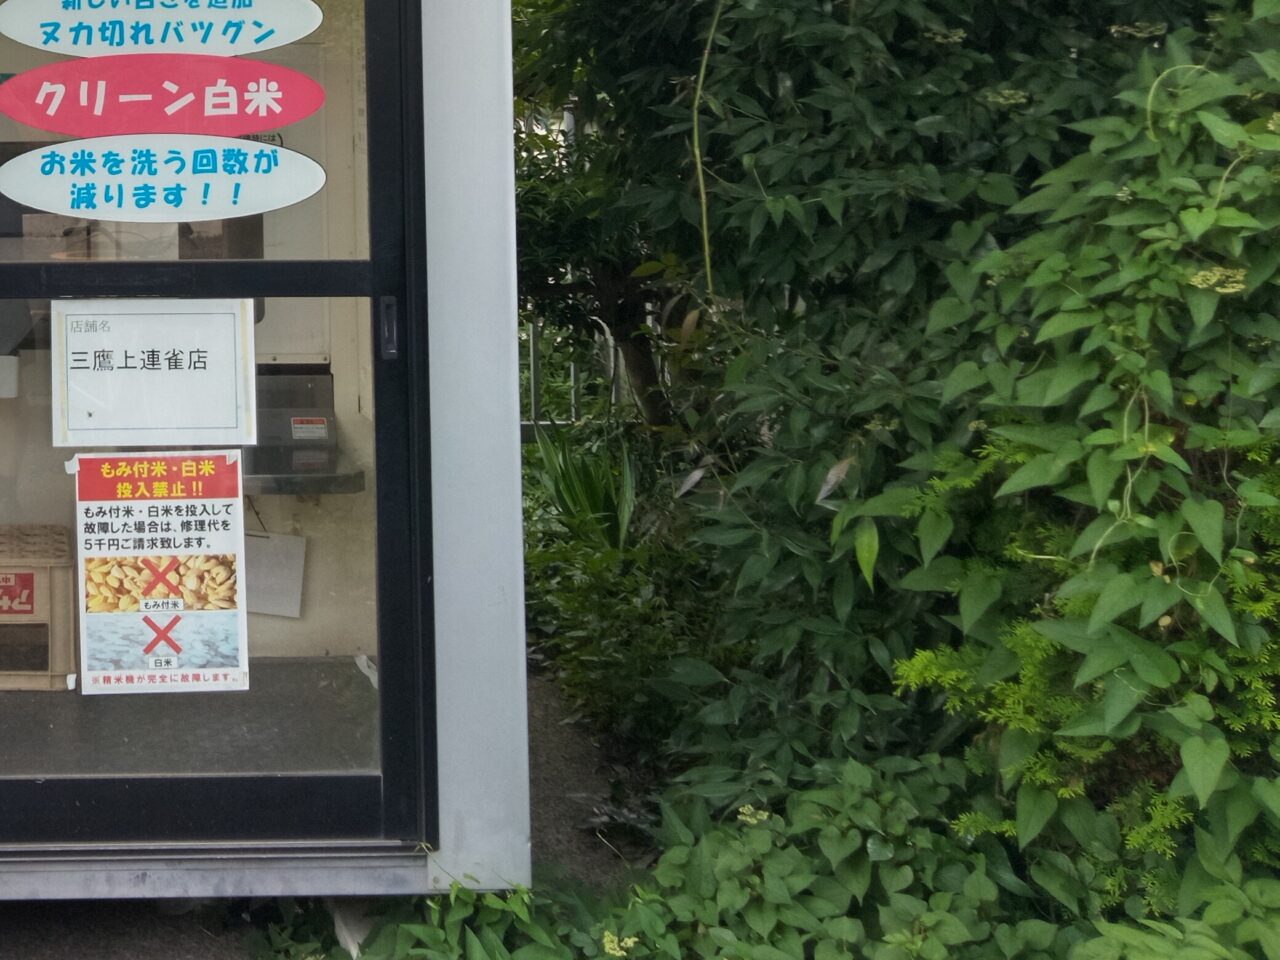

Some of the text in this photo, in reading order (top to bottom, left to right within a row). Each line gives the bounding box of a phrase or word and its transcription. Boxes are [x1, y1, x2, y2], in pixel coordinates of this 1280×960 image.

[39, 20, 276, 48] ヌカ切れバツグン
[35, 78, 283, 117] クリーン白米
[39, 148, 280, 177] お米を洗う回数が
[70, 320, 111, 333] 店舗名
[70, 348, 208, 372] 三鷹上連雀店
[101, 460, 216, 478] もみ付米・白米
[84, 503, 234, 518] もみ付米・白米を投入して
[84, 520, 231, 535] 故障した場合は、修理代を
[144, 601, 179, 610] もみ付米
[154, 658, 173, 668] 白米
